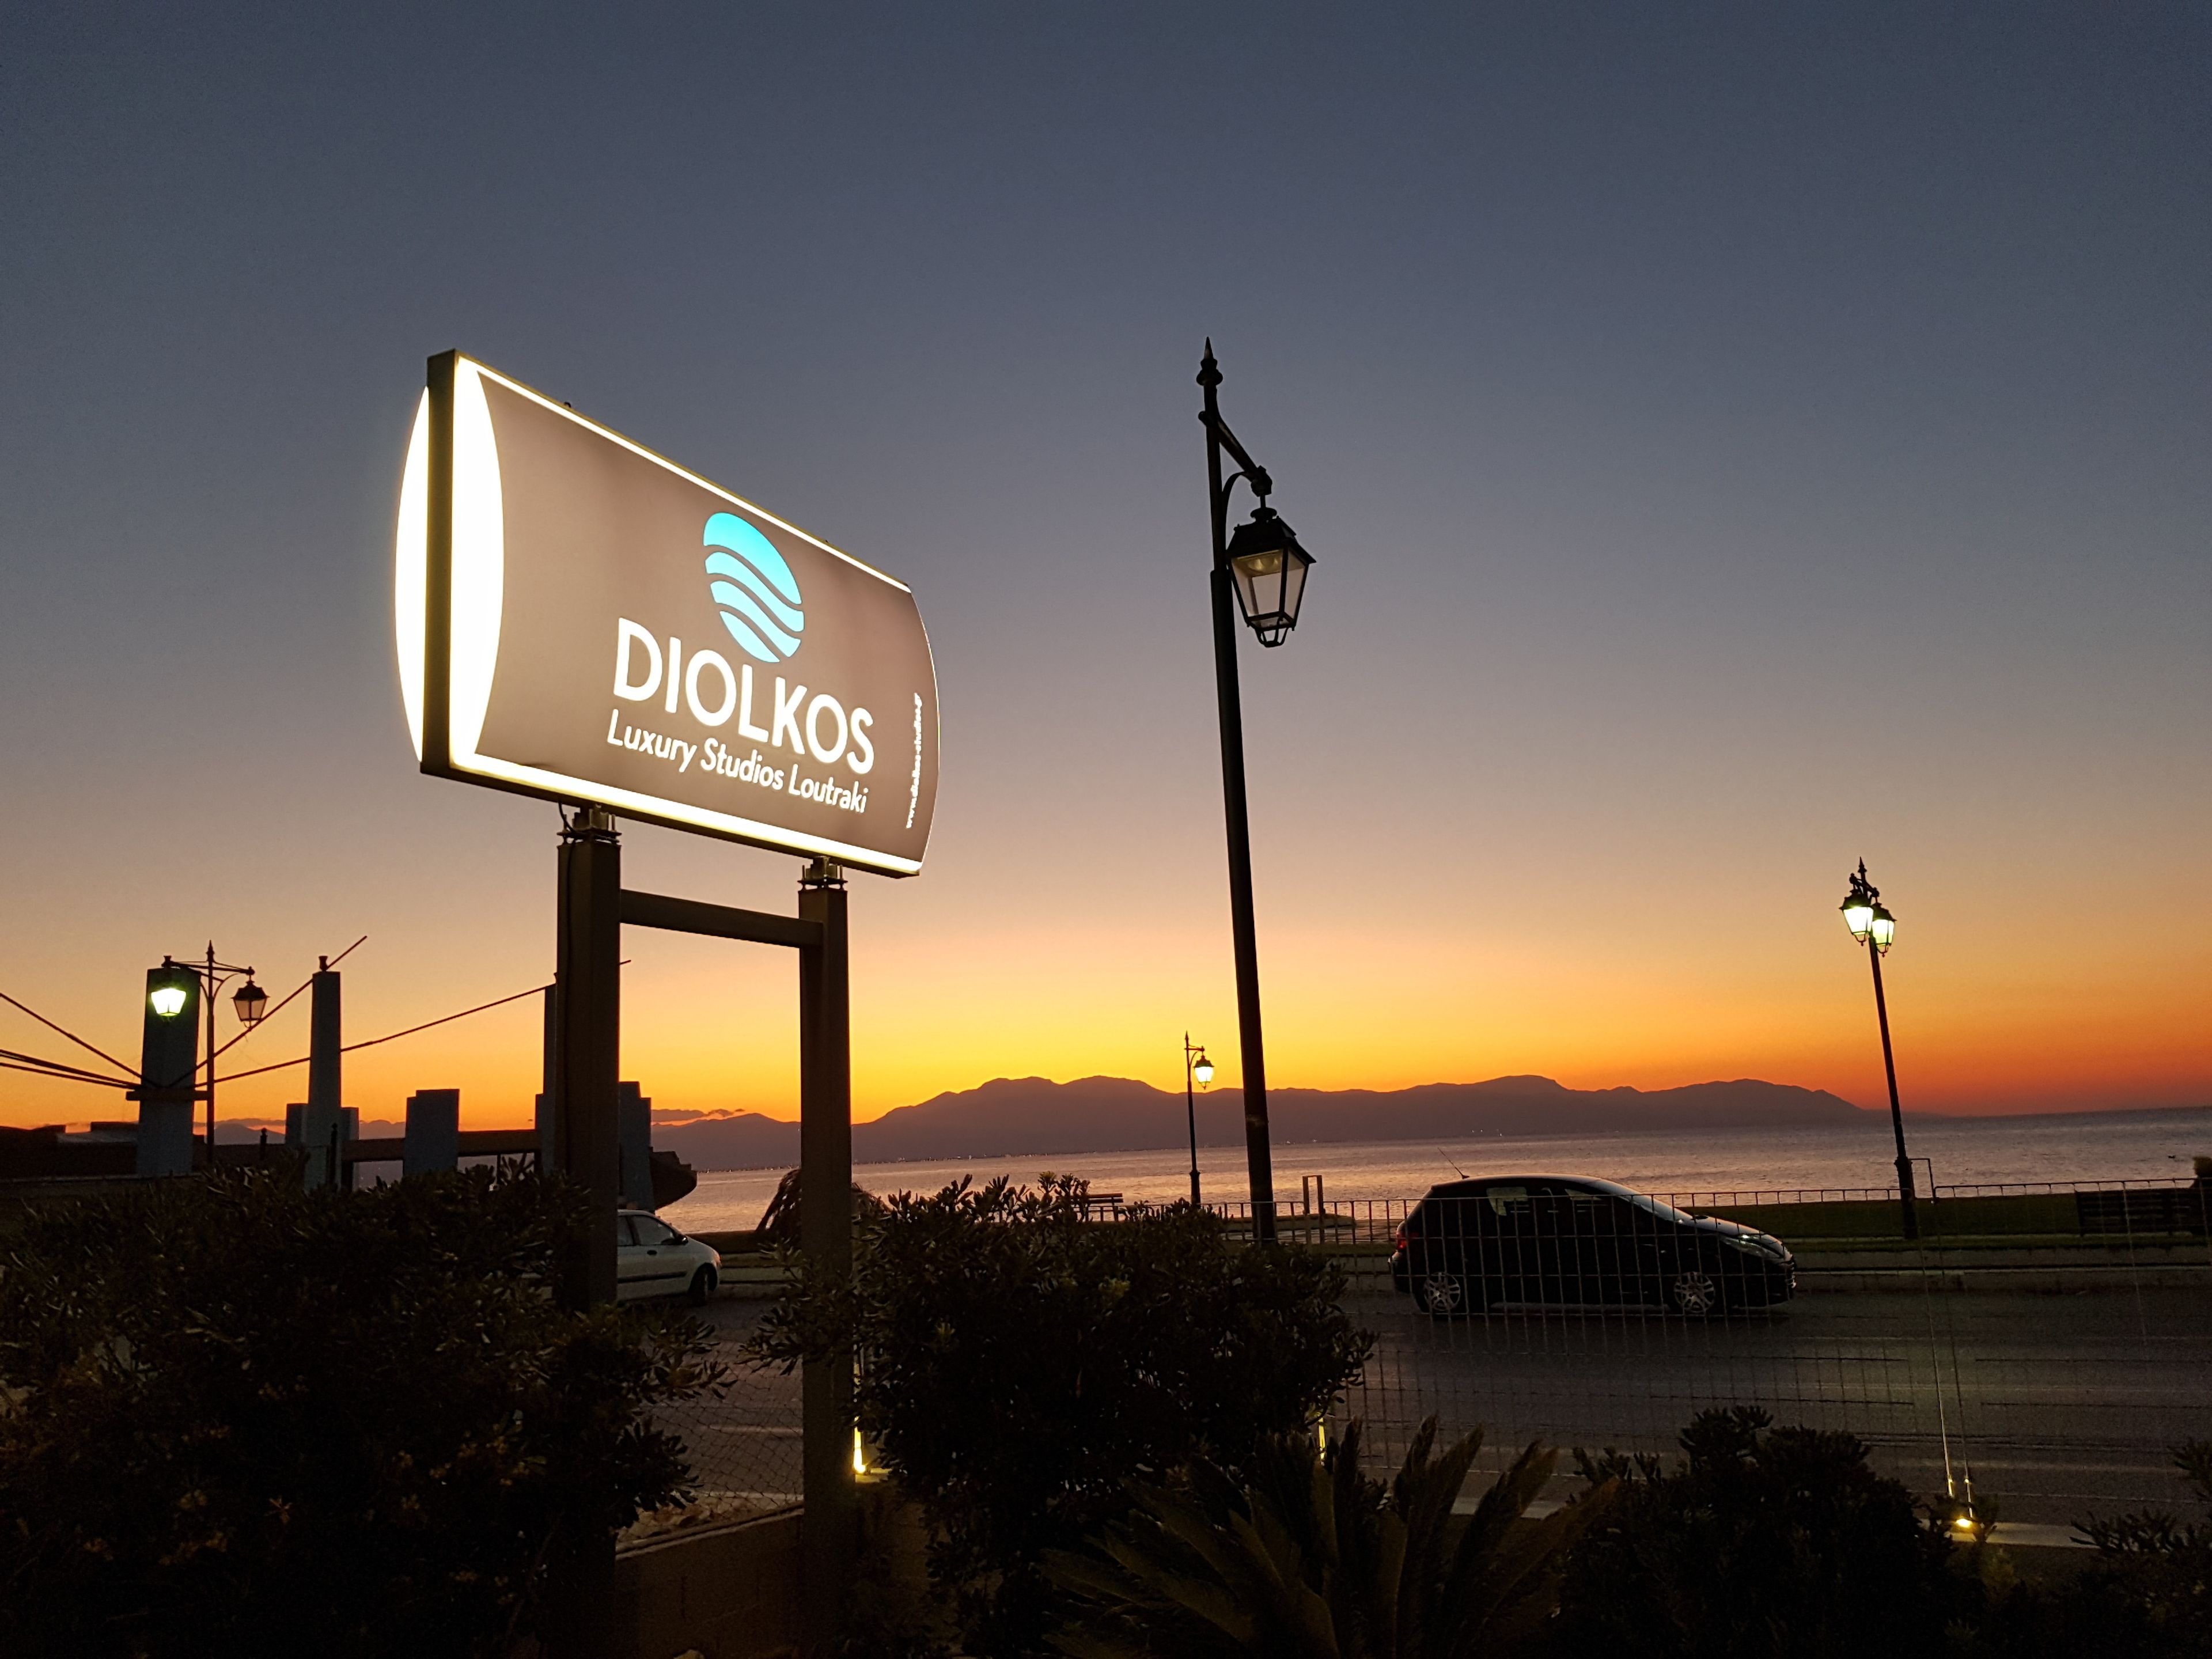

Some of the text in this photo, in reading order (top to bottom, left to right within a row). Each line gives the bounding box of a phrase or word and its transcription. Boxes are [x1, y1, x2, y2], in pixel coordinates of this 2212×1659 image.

[607, 708, 869, 813] Luxury Studios Loutraki
[613, 617, 875, 775] DIOLKOS
